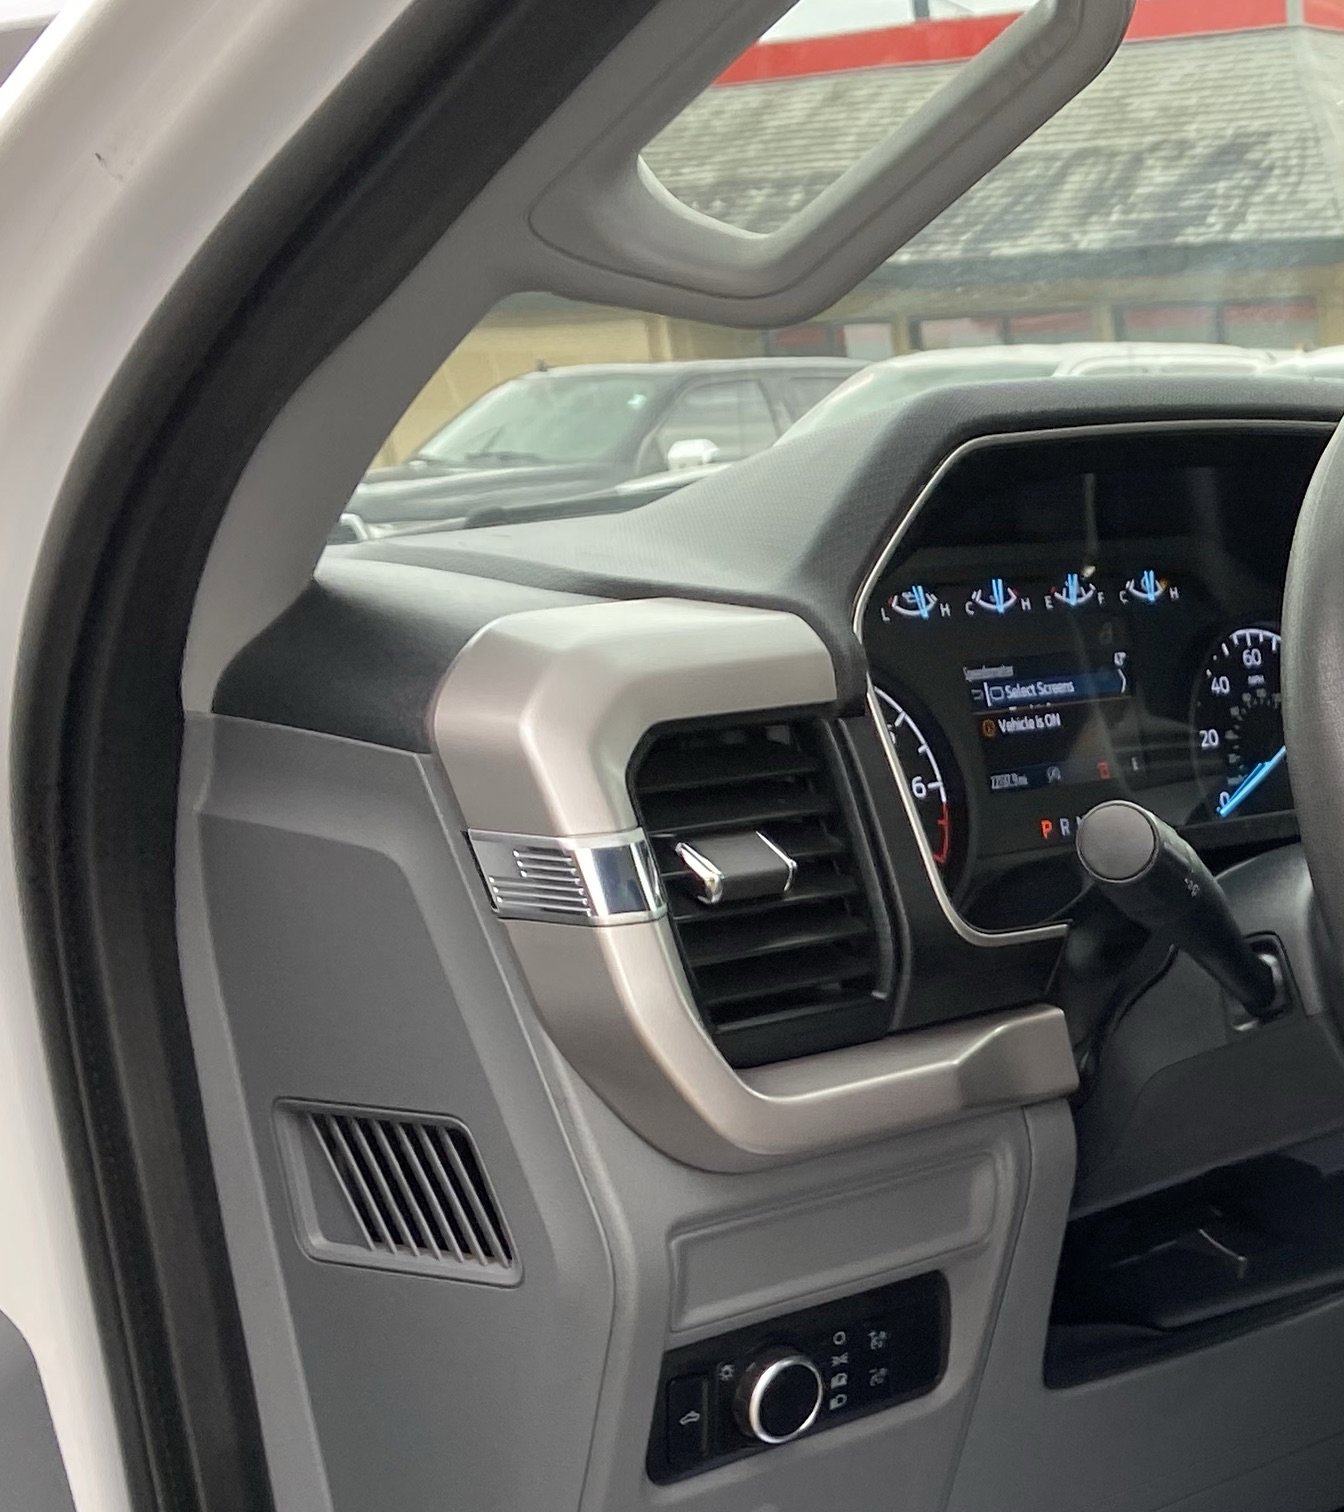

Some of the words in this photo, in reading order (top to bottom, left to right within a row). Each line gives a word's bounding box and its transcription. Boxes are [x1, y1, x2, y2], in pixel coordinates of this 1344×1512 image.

[1044, 595, 1054, 610] E
[1119, 590, 1129, 604] C
[1169, 586, 1180, 600] H
[940, 603, 952, 618] H
[965, 601, 975, 616] C
[1021, 597, 1032, 612] H
[1242, 647, 1263, 668] 60
[1005, 683, 1037, 700] Select
[1037, 681, 1075, 697] Screens
[1210, 675, 1231, 695] 40
[997, 713, 1035, 734] Vehicle
[1035, 714, 1045, 729] is
[1044, 712, 1062, 729] ON
[1199, 728, 1220, 749] 20
[910, 775, 927, 799] 6
[1040, 819, 1053, 840] P
[1059, 817, 1071, 837] R
